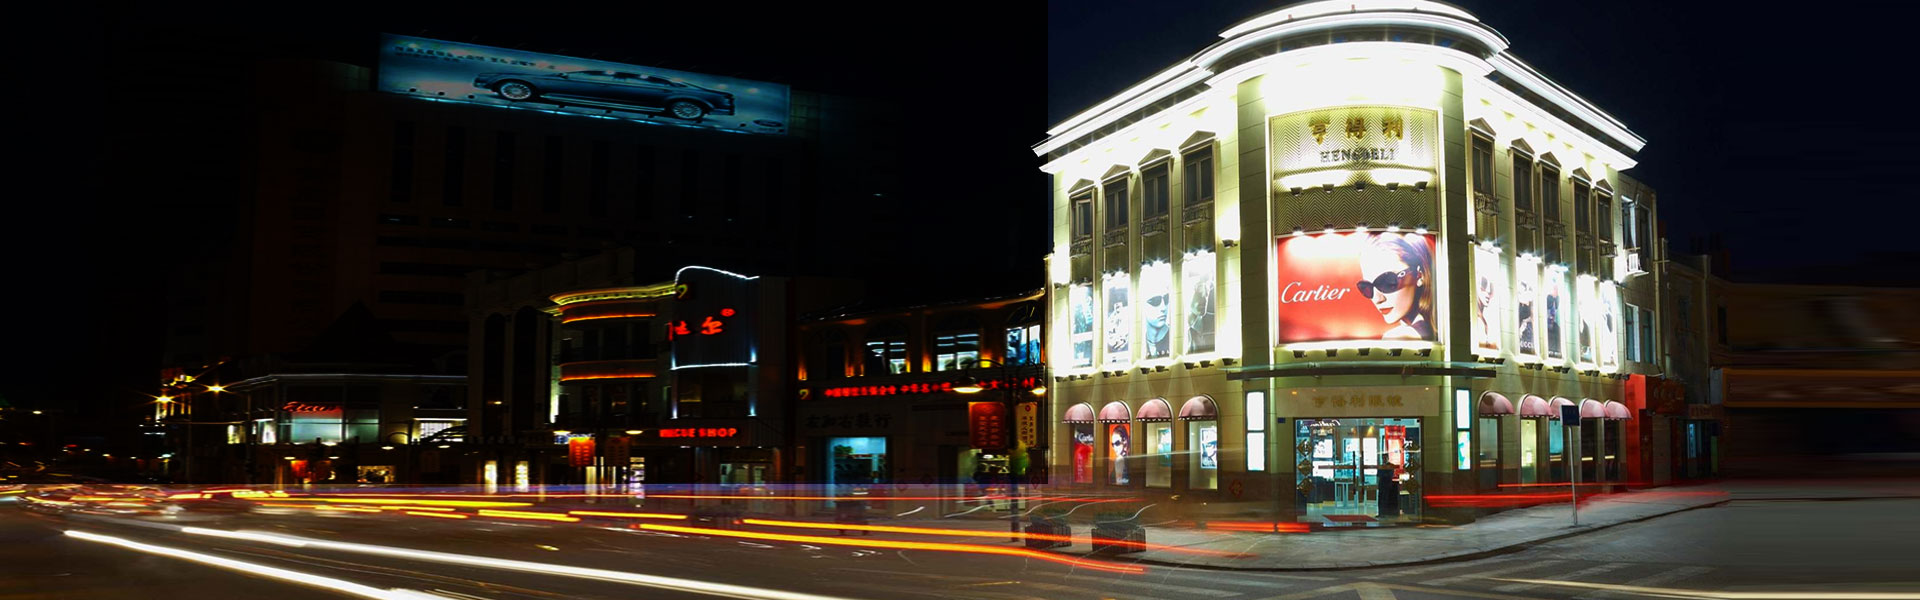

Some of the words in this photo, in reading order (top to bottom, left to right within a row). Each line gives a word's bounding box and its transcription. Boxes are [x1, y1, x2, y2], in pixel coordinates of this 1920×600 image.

[1308, 116, 1403, 145] 亨得利
[1281, 281, 1350, 303] Cartier
[698, 427, 738, 438] SHOP
